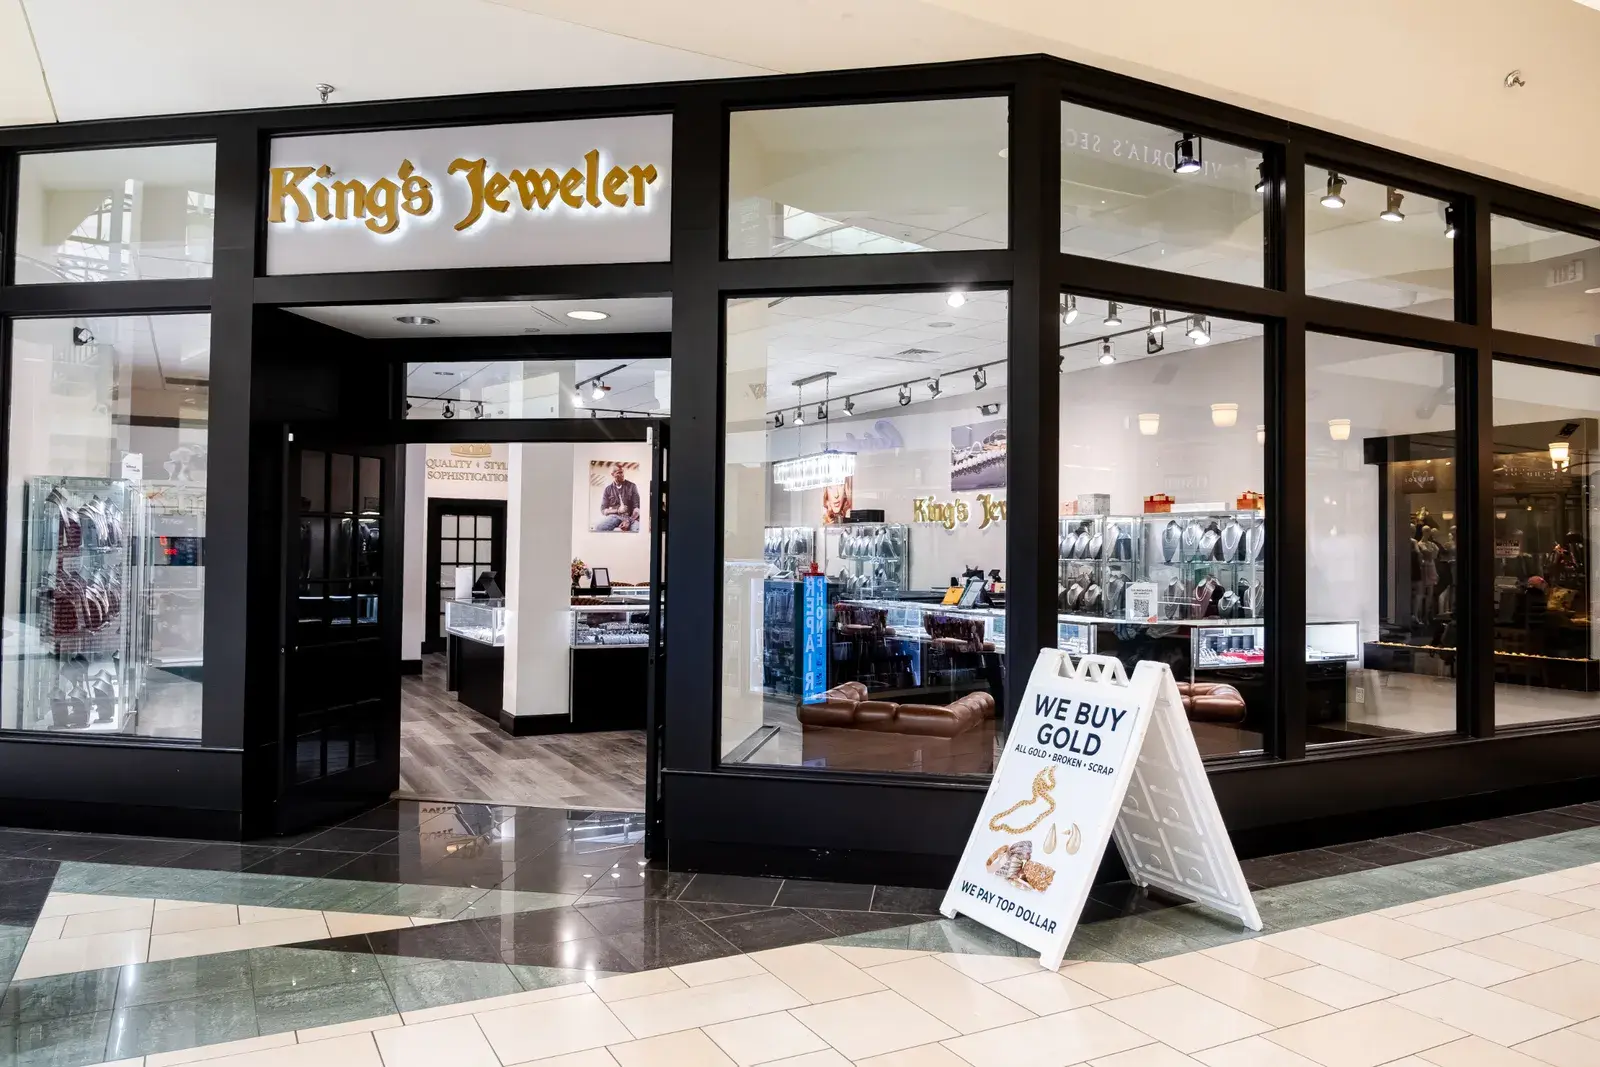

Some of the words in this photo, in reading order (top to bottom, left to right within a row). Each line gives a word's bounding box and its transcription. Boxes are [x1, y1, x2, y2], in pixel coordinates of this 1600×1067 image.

[267, 158, 433, 235] King's
[447, 148, 658, 232] Jeweler
[426, 458, 473, 469] QUALITY
[484, 461, 508, 471] STYL
[912, 495, 969, 530] King's
[1035, 694, 1072, 721] WE
[1074, 701, 1128, 732] BUY
[1036, 723, 1102, 756] GOLD
[1014, 743, 1028, 755] ALL
[1027, 747, 1047, 759] GOLD
[1051, 753, 1083, 769] BROKEN
[1087, 762, 1114, 776] SCRAP
[961, 880, 978, 897] WE
[976, 887, 996, 905] PAY
[996, 895, 1016, 913] TOP
[1015, 905, 1057, 934] DOLLAR
